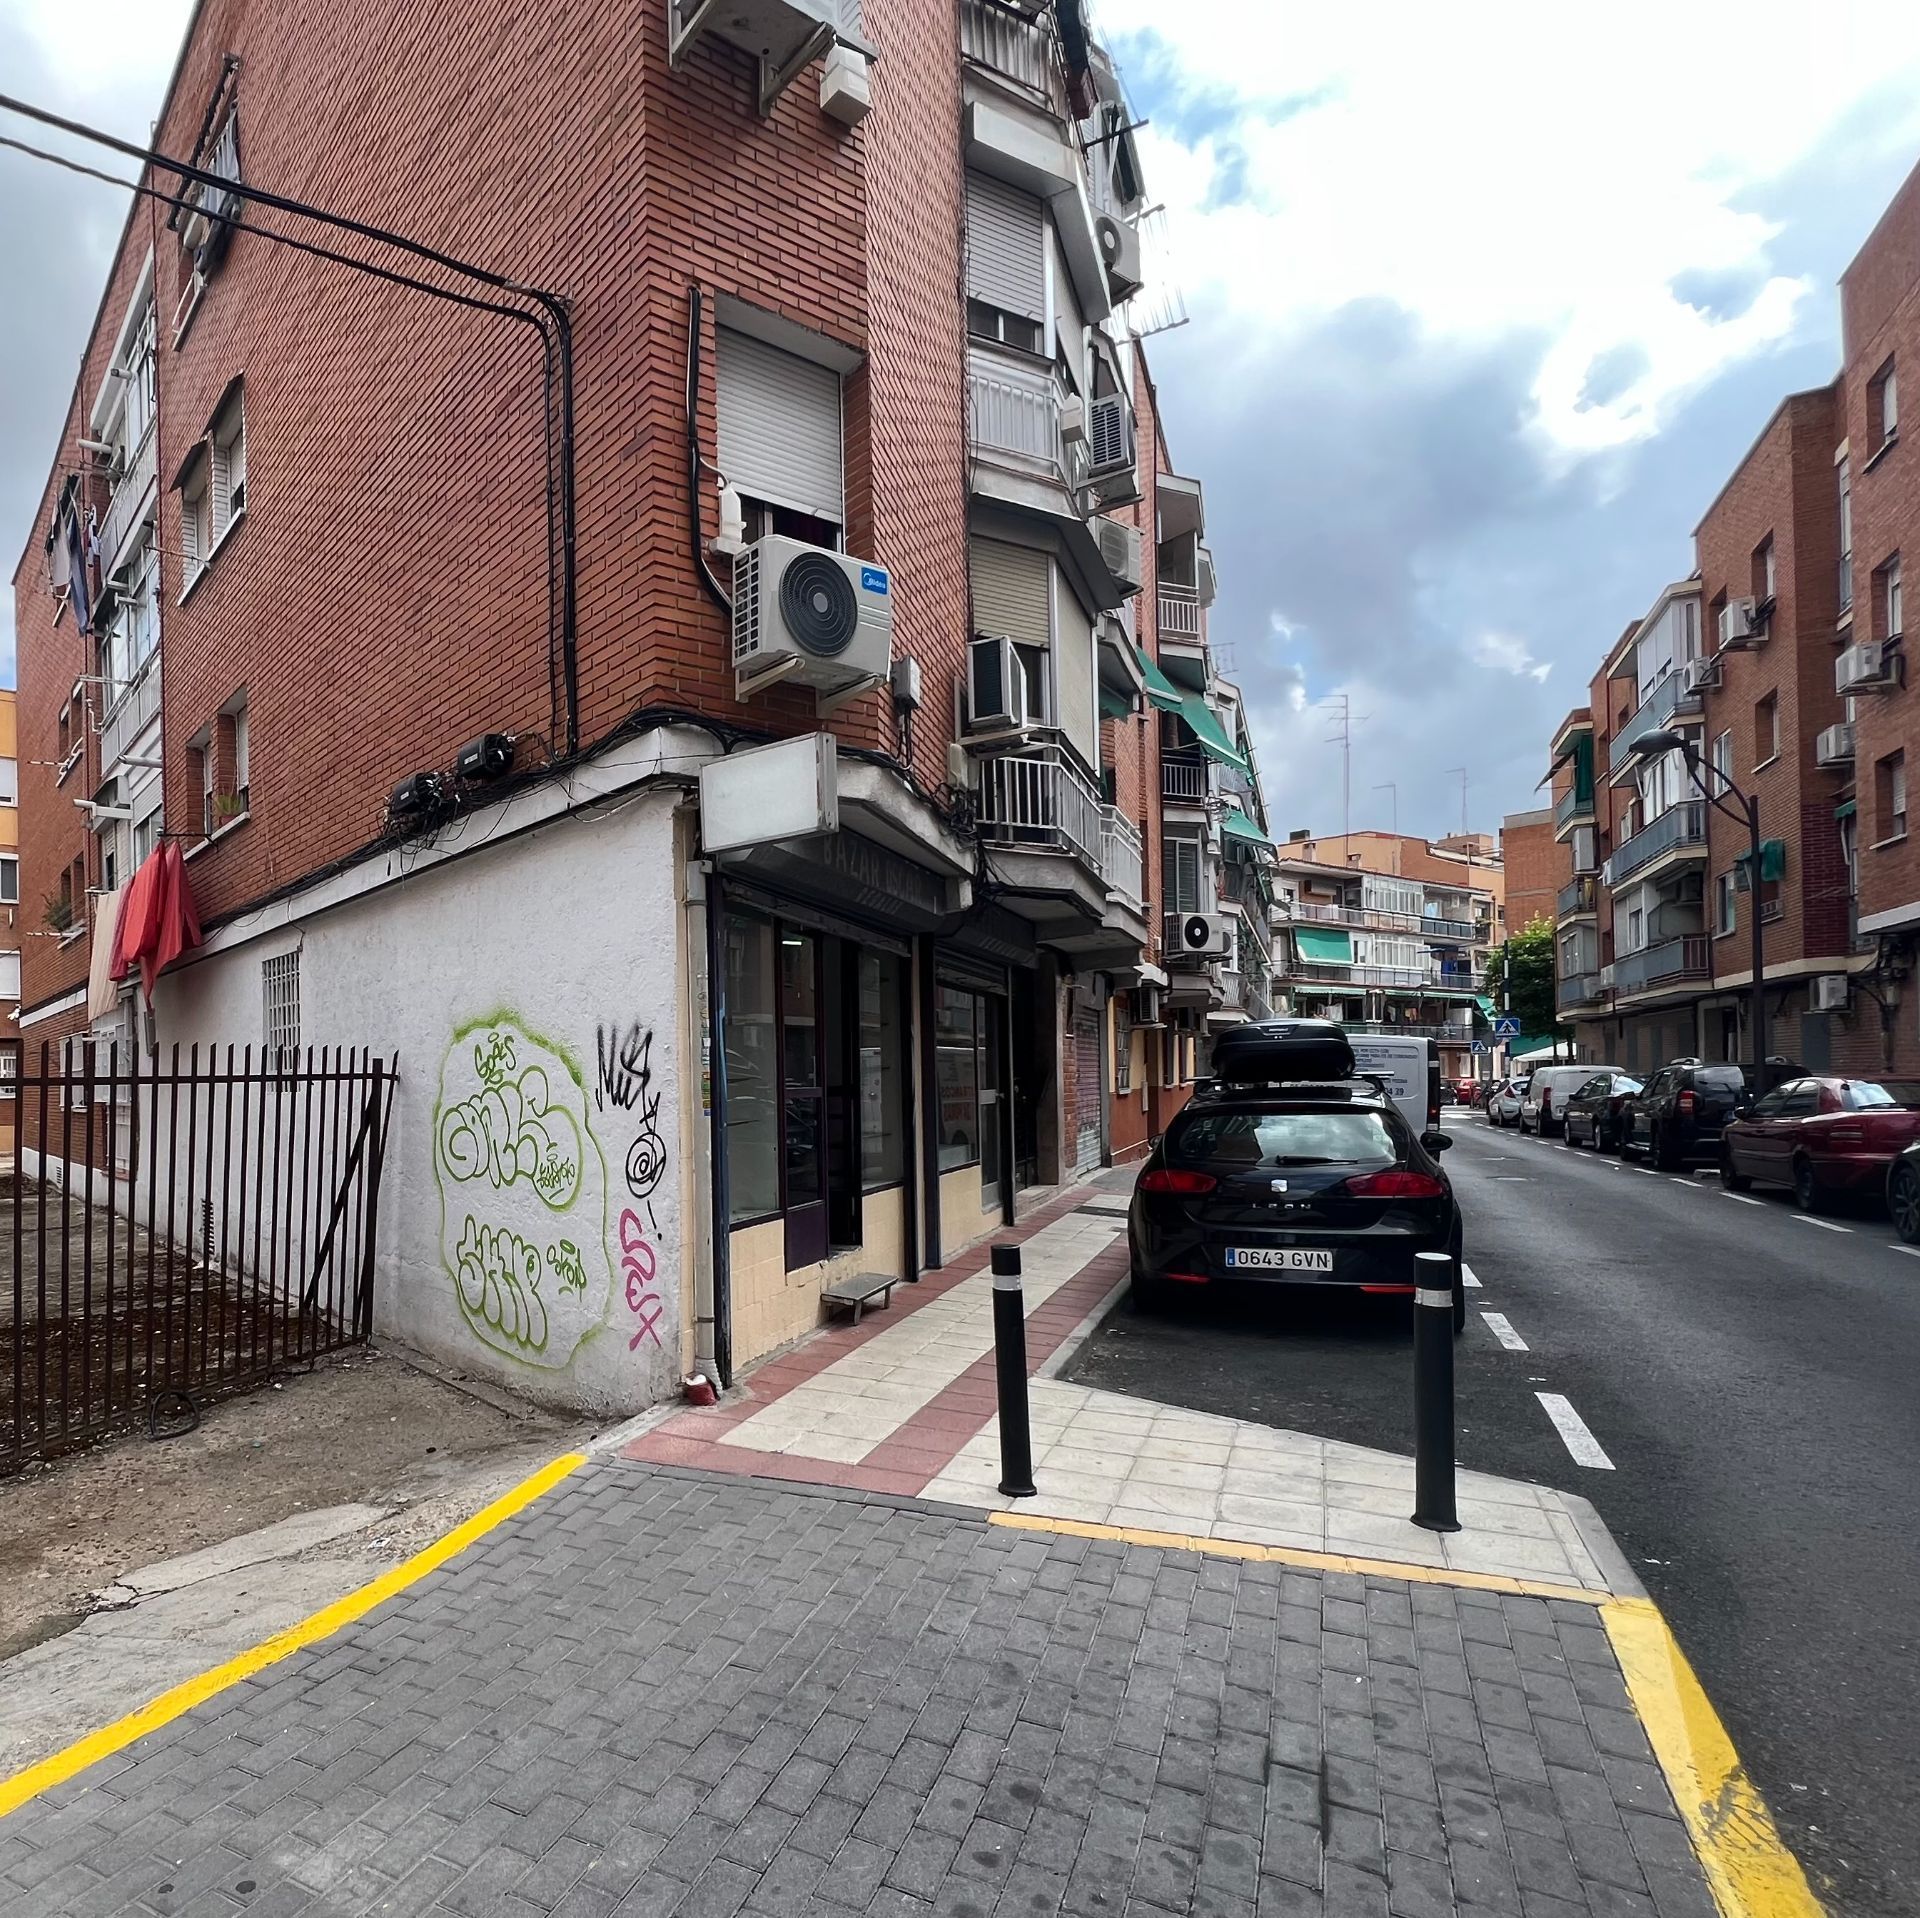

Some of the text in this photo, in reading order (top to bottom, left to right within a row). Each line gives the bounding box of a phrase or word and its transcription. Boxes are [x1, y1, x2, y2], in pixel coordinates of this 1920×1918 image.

[823, 835, 880, 888] BAZAR
[1238, 1250, 1328, 1269] 0643 GVN
